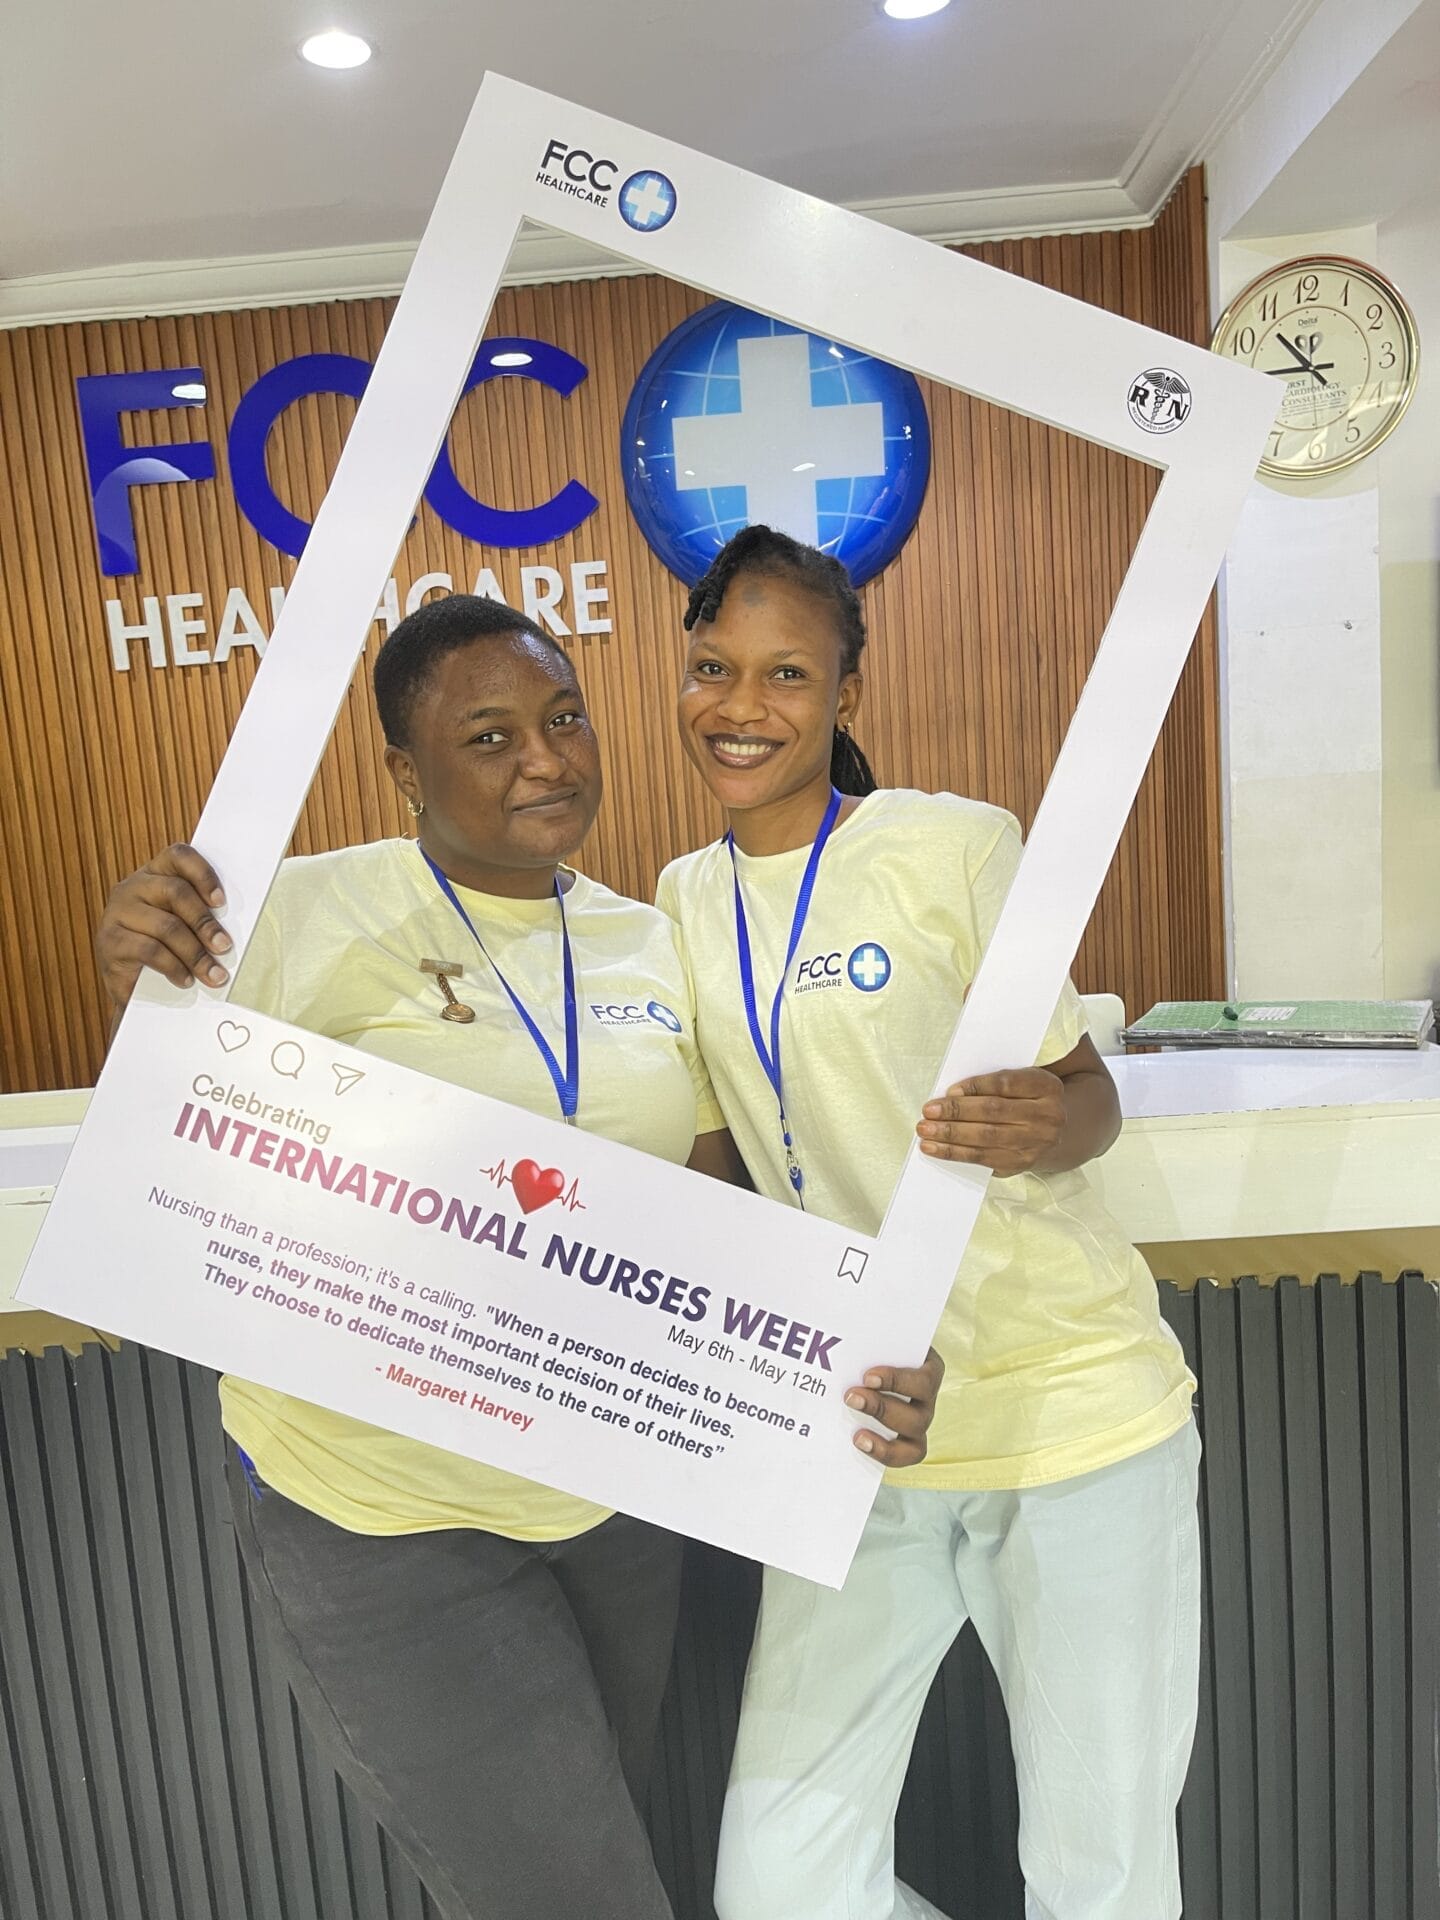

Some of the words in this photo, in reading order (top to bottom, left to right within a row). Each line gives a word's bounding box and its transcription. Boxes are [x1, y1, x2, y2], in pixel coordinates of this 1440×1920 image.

[540, 139, 619, 191] FCC
[535, 172, 609, 208] HEALTHCARE
[1292, 275, 1320, 305] 12
[1339, 279, 1350, 307] 1
[1258, 292, 1278, 321] 11
[1366, 304, 1383, 331] 2
[1229, 327, 1255, 356] 10
[1379, 342, 1396, 369] 3
[1129, 385, 1150, 407] R
[1166, 399, 1189, 421] N
[1367, 380, 1384, 408] 4
[1268, 430, 1284, 457] 7
[1345, 416, 1361, 443] 5
[1308, 432, 1323, 460] 6
[796, 952, 842, 984] FCC
[794, 978, 842, 994] HEALTHCARE
[590, 1004, 643, 1021] FCC
[192, 1074, 331, 1145] Celebrating
[173, 1102, 527, 1260] INTERNATIONAL
[542, 1234, 711, 1322] NURSES
[723, 1297, 842, 1372] WEEK
[148, 1186, 216, 1228] Nursing
[220, 1212, 258, 1239] than
[262, 1232, 274, 1245] a
[276, 1236, 372, 1282] profession;
[376, 1267, 400, 1289] it's
[403, 1281, 415, 1295] a
[419, 1286, 477, 1319] calling.
[487, 1305, 544, 1341] "When
[547, 1333, 560, 1346] a
[561, 1337, 626, 1370] person
[630, 1360, 699, 1396] decides
[703, 1386, 721, 1404] to
[725, 1393, 796, 1431] become
[798, 1424, 811, 1437] a
[203, 1263, 249, 1296] They
[251, 1284, 320, 1318] choose
[324, 1307, 342, 1326] to
[347, 1316, 425, 1356] dedicate
[429, 1345, 532, 1393] themselves
[536, 1383, 554, 1401] to
[558, 1390, 587, 1413] the
[591, 1405, 630, 1428] care
[634, 1421, 655, 1437] of
[206, 1239, 264, 1273] nurse,
[269, 1259, 311, 1289] they
[314, 1277, 364, 1305] make
[367, 1294, 397, 1316] the
[400, 1308, 449, 1335] most
[451, 1323, 540, 1368] important
[542, 1357, 618, 1396] decision
[622, 1388, 643, 1404] of
[645, 1393, 687, 1420] their
[689, 1408, 735, 1439] lives.
[667, 1325, 705, 1354] May
[708, 1341, 735, 1363] 6th
[750, 1355, 787, 1384] May
[792, 1372, 827, 1397] 12th
[385, 1363, 467, 1406] Margaret
[470, 1393, 535, 1432] Harvey
